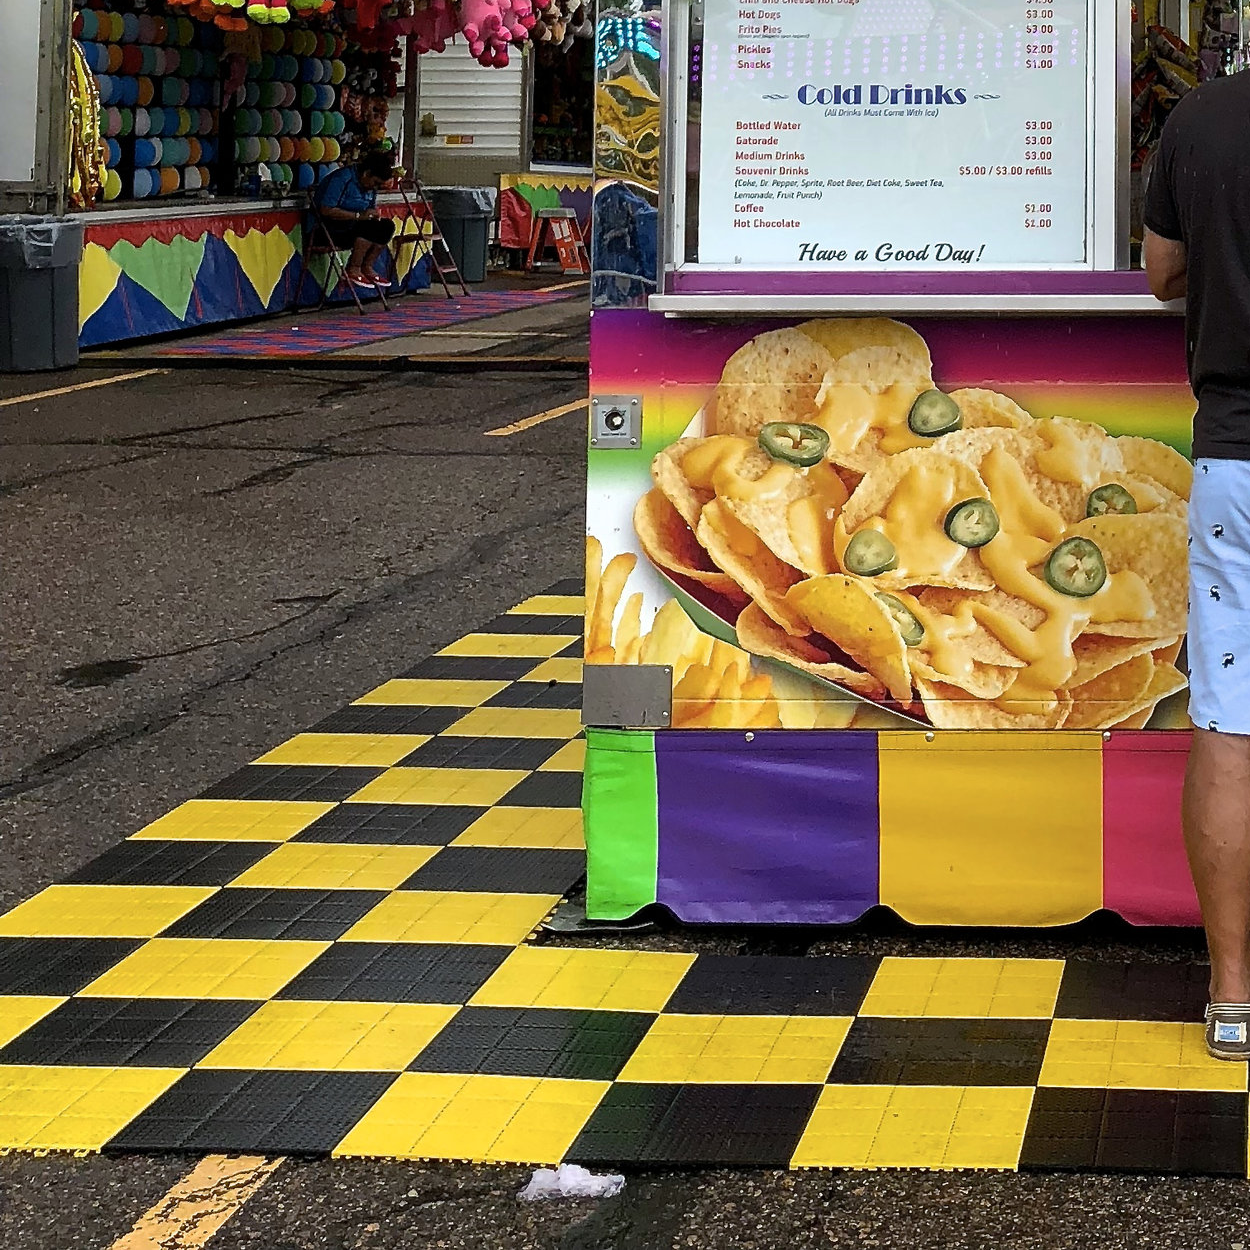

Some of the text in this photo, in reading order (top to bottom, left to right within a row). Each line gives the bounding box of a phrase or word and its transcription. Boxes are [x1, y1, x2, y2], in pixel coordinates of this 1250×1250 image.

[738, 10, 781, 20] Hot Dogs
[738, 24, 782, 34] Frito Pies
[737, 44, 772, 54] Pickles
[1026, 44, 1053, 54] $2.00
[737, 59, 771, 69] Snacks
[1026, 59, 1053, 69] $1.00
[797, 84, 967, 105] Cold Drinks
[824, 108, 939, 118] (All Drinks Must Come With Ice)
[736, 121, 801, 130] Bottled Water
[1025, 121, 1052, 131] $3.00
[736, 136, 779, 145] Gatorade
[1025, 136, 1052, 146] $3.00
[735, 151, 805, 161] Medium Drinks
[1025, 151, 1052, 161] $3.00
[735, 166, 809, 176] Souvenir Drinks
[959, 166, 986, 176] $5.00
[995, 166, 1022, 176] $3.00
[1025, 166, 1052, 176] refills
[734, 179, 758, 188] (Coke,
[772, 179, 799, 188] Pepper,
[801, 179, 825, 188] Sprite,
[827, 179, 845, 188] Root
[846, 179, 865, 188] Beer,
[866, 179, 881, 188] Diet
[883, 179, 903, 188] Coke,
[904, 179, 928, 188] Sweet
[929, 179, 944, 188] Tea,
[734, 191, 823, 200] Lemonade, Fruit Punch)
[734, 204, 764, 213] Coffee
[733, 219, 801, 228] Hot Chocolate
[798, 243, 985, 263] Have a Good Day!
